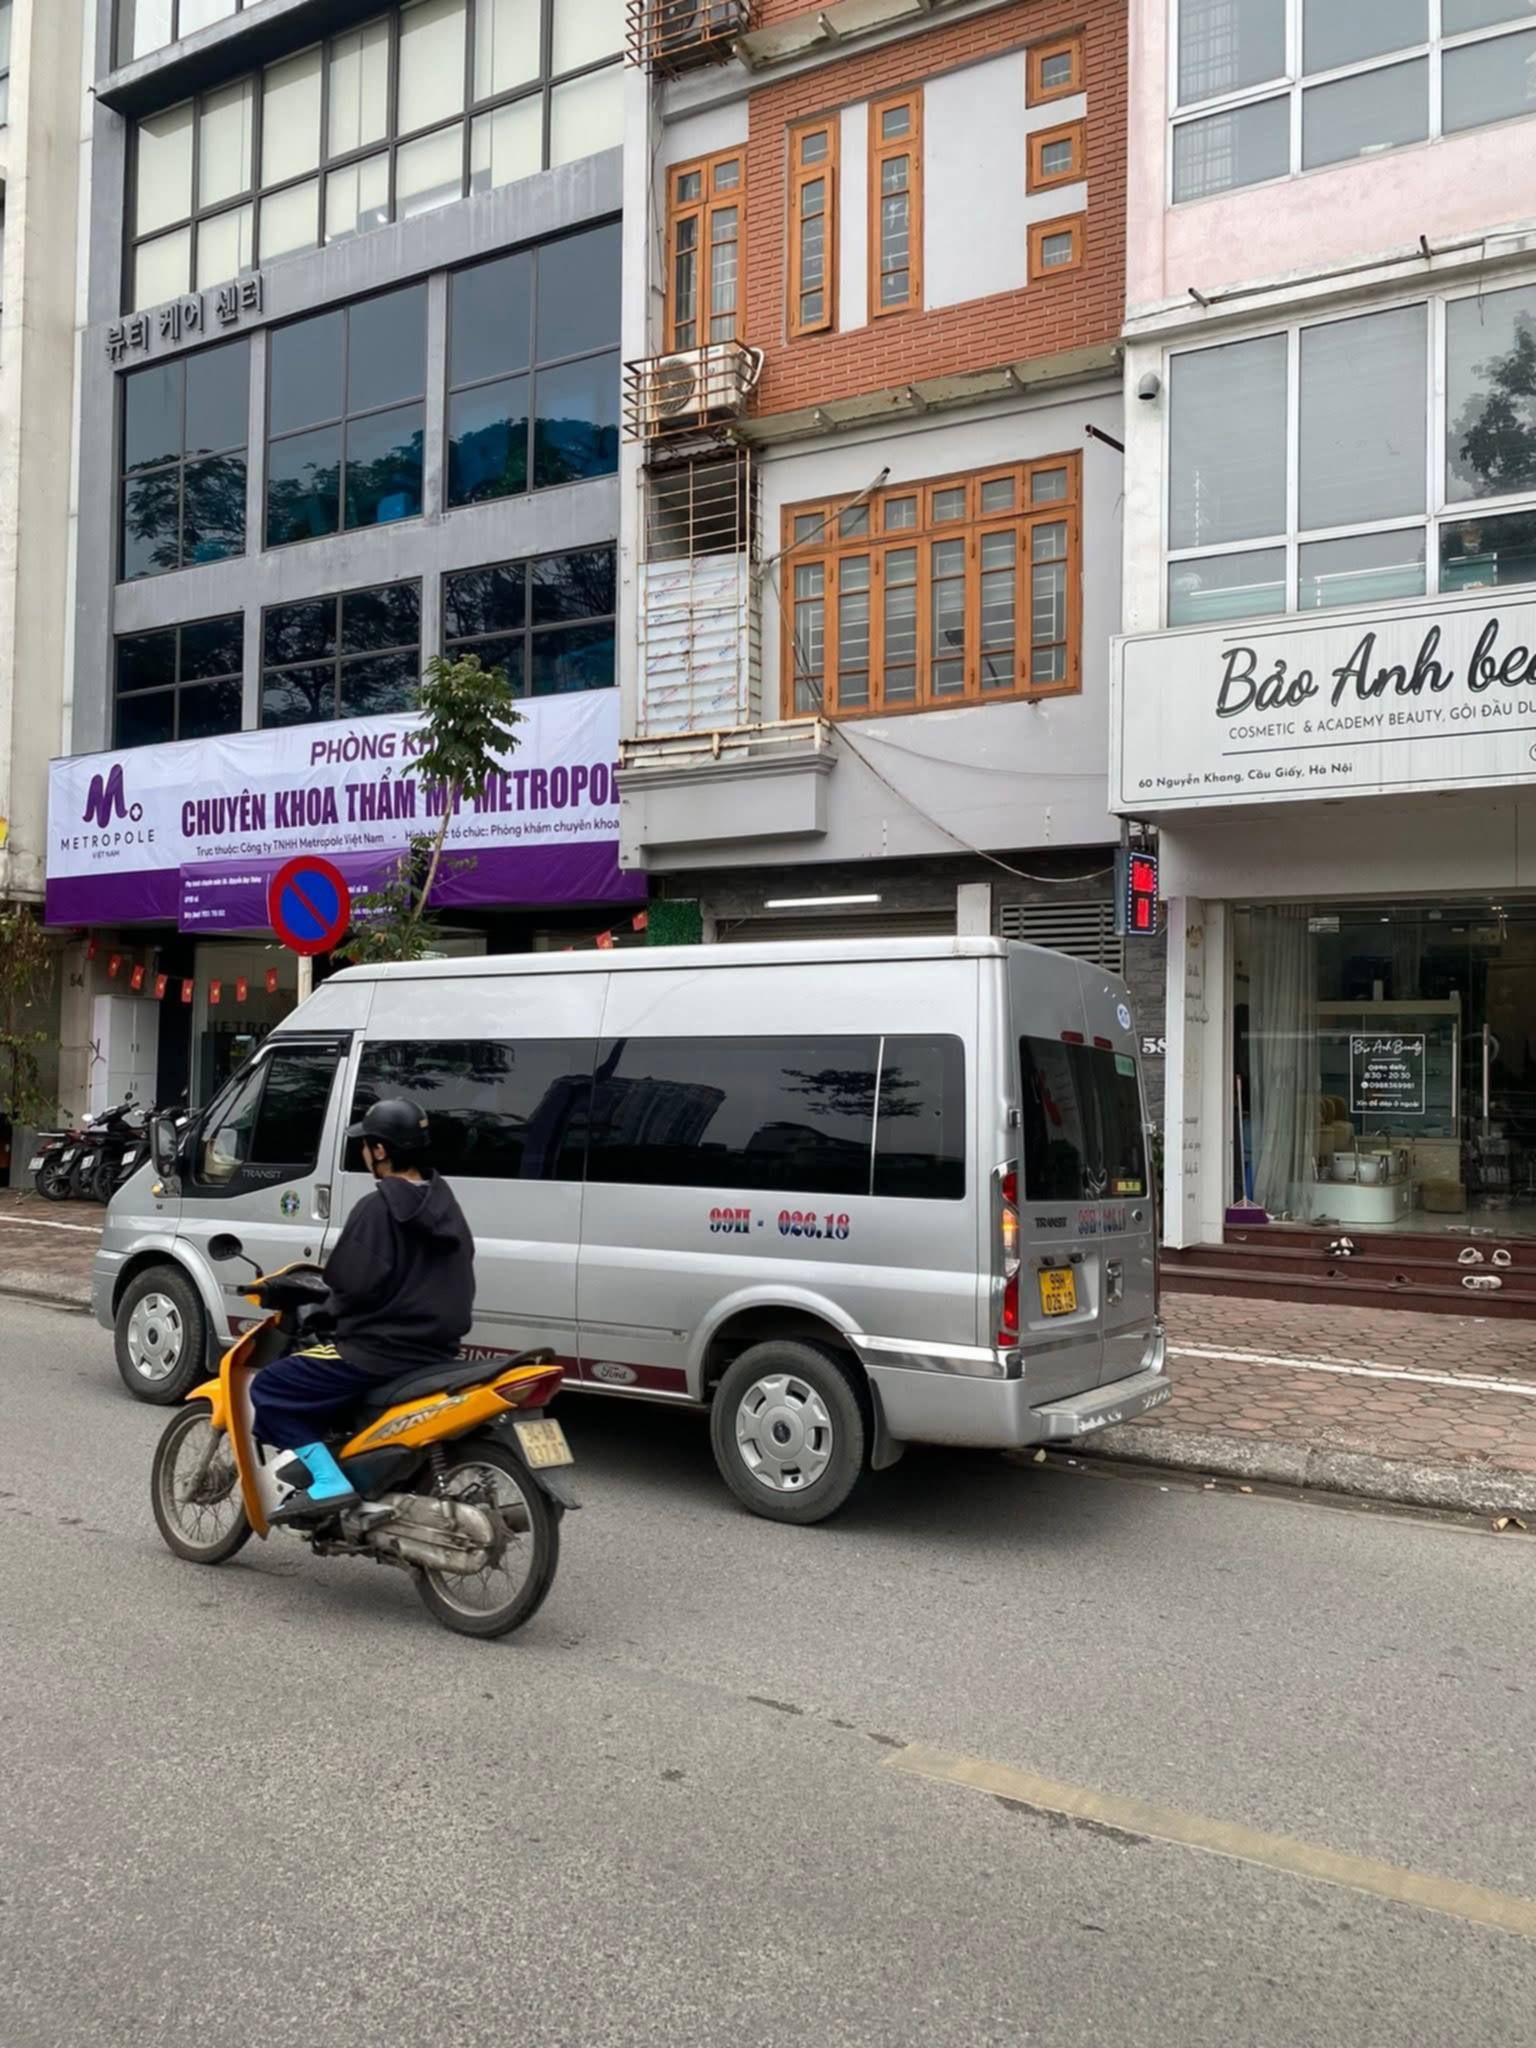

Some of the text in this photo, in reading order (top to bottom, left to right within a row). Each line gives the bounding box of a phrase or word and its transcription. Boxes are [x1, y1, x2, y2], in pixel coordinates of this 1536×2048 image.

[160, 293, 205, 340] 케어
[216, 274, 264, 326] 센터
[1216, 647, 1319, 718] Bảo
[1331, 625, 1454, 707] Anh
[1229, 722, 1296, 739] COSMETIC
[1303, 720, 1312, 733] &
[1317, 714, 1384, 731] ACADEMY
[1389, 709, 1446, 725] BEAUTY,
[310, 731, 396, 767] PHÒNG
[1138, 778, 1153, 789] 60
[181, 788, 267, 838] CHUYÊN
[274, 786, 339, 829] KHOA
[345, 766, 416, 823] THẨM
[61, 829, 155, 851] METROPOLE
[273, 839, 297, 850] TNHH
[299, 835, 343, 849] Metropole
[363, 832, 384, 844] Nam
[593, 817, 619, 830] khoa
[709, 1207, 751, 1234] 99H
[777, 1209, 850, 1240] 026.18
[600, 1365, 628, 1380] Ford
